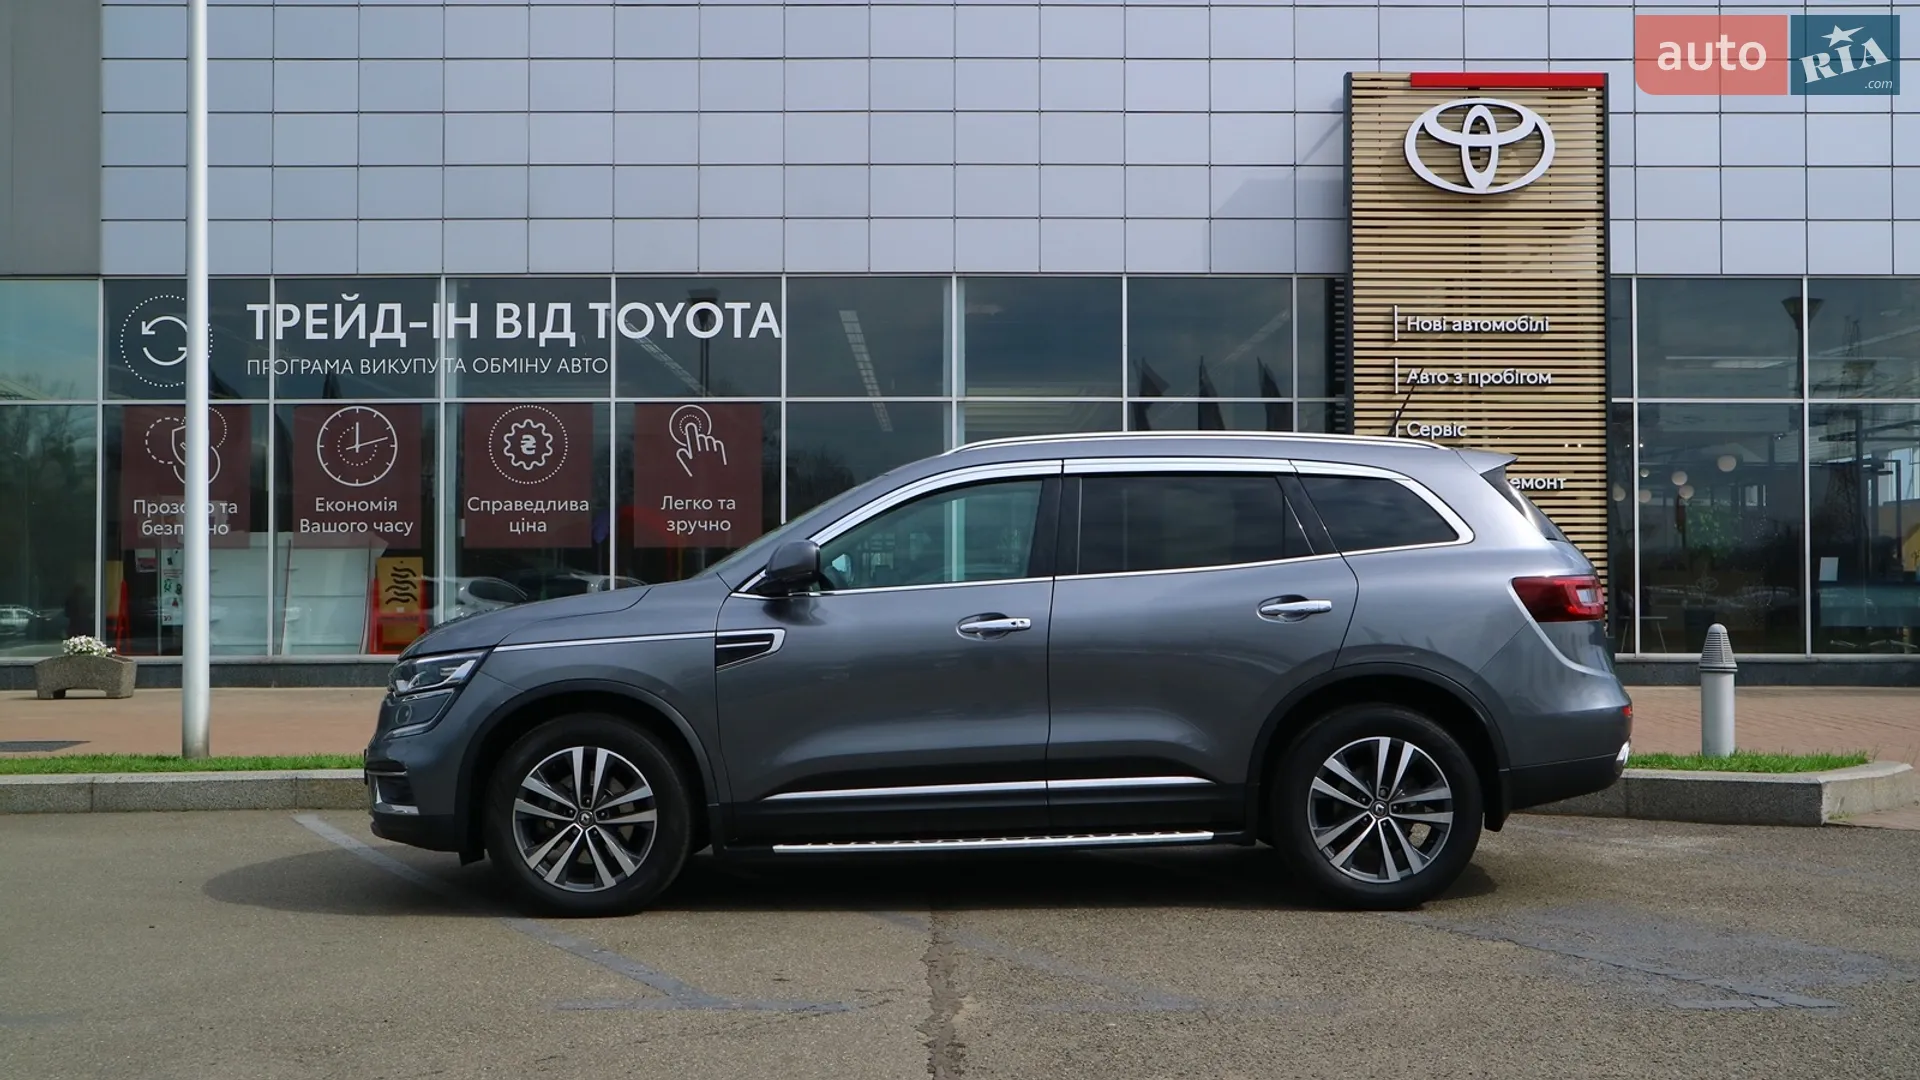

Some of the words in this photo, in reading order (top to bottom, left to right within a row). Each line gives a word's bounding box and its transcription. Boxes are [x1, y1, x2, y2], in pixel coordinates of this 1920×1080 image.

[246, 293, 478, 347] ТРЕЙД-ІН
[496, 302, 576, 347] ВІД
[589, 301, 782, 339] TOYOTA
[1406, 316, 1447, 332] Нові
[1452, 316, 1549, 332] автомобілі
[247, 358, 354, 375] ПРОГРАМА
[360, 357, 440, 374] ВИКУПУ
[444, 357, 467, 373] ТА
[472, 357, 552, 374] ОБМІНУ
[557, 357, 609, 373] АВТО
[1406, 369, 1449, 384] Авто
[1453, 371, 1463, 384] з
[1468, 368, 1552, 387] пробігом
[1406, 421, 1468, 440] Сервіс
[1509, 477, 1567, 490] емонт
[133, 499, 215, 518] Прозо
[219, 502, 238, 514] та
[315, 497, 397, 512] Економія
[467, 497, 590, 515] Справедлива
[660, 496, 713, 511] Легко
[718, 499, 736, 511] та
[141, 519, 229, 536] безпно
[300, 518, 367, 533] Вашого
[373, 521, 413, 536] часу
[509, 520, 547, 534] ціна
[666, 520, 731, 534] зручно
